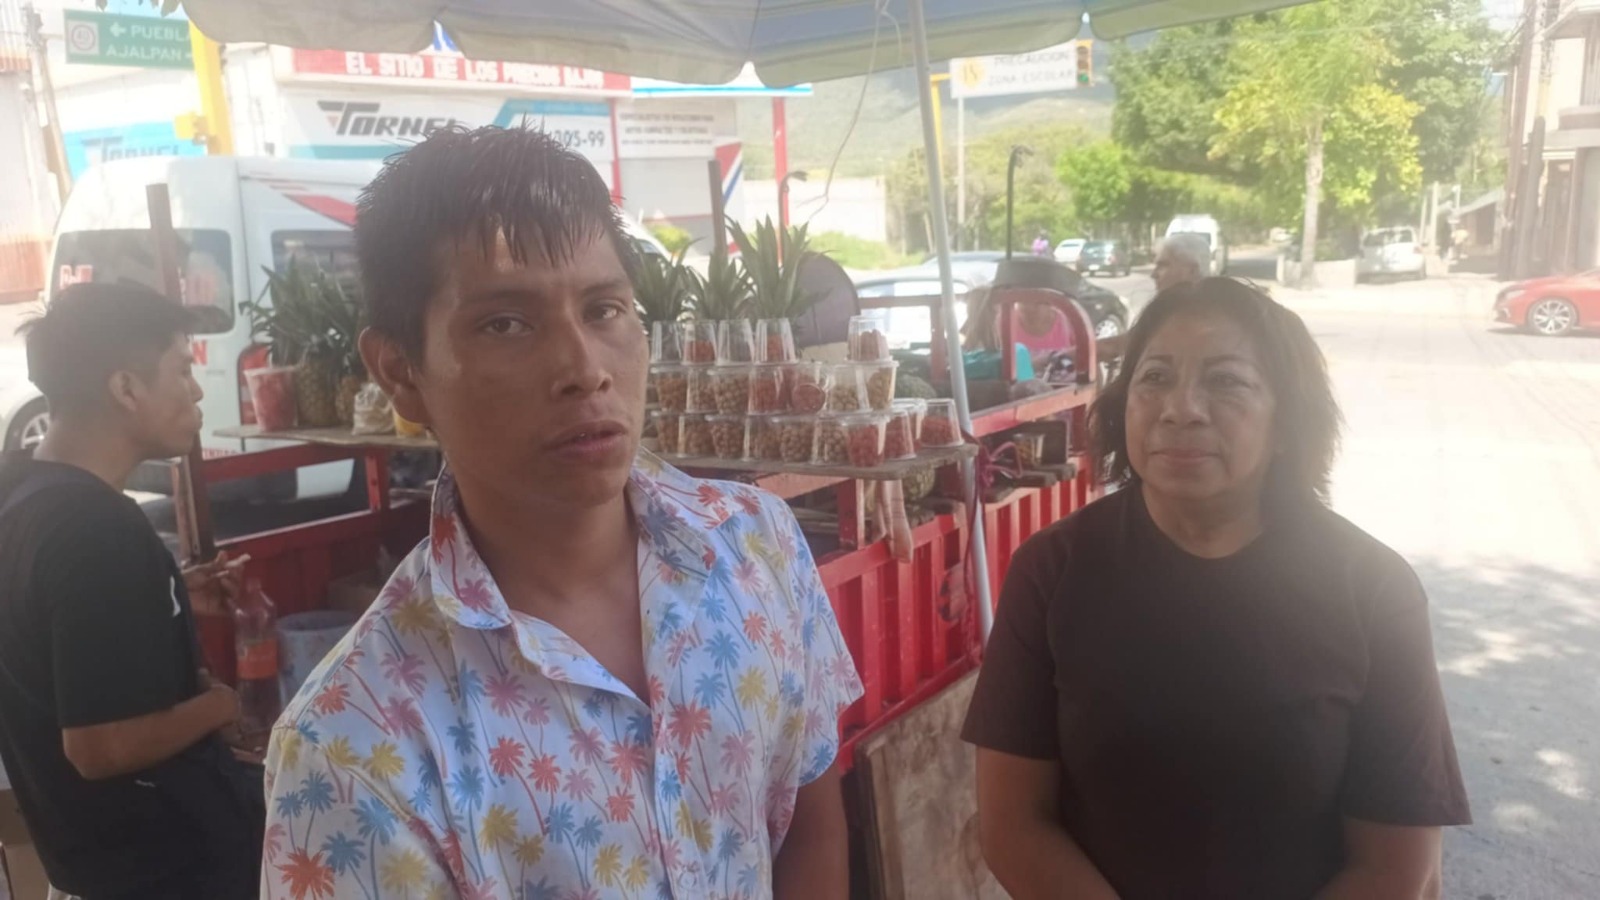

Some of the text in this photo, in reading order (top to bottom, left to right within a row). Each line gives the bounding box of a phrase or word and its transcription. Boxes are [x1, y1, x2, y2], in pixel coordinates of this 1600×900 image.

[131, 25, 190, 41] PUEBL
[106, 44, 182, 61] AJALPAN
[345, 51, 373, 75] EL
[379, 53, 425, 78] SITIO
[433, 56, 458, 80] DE
[464, 59, 499, 83] LOS
